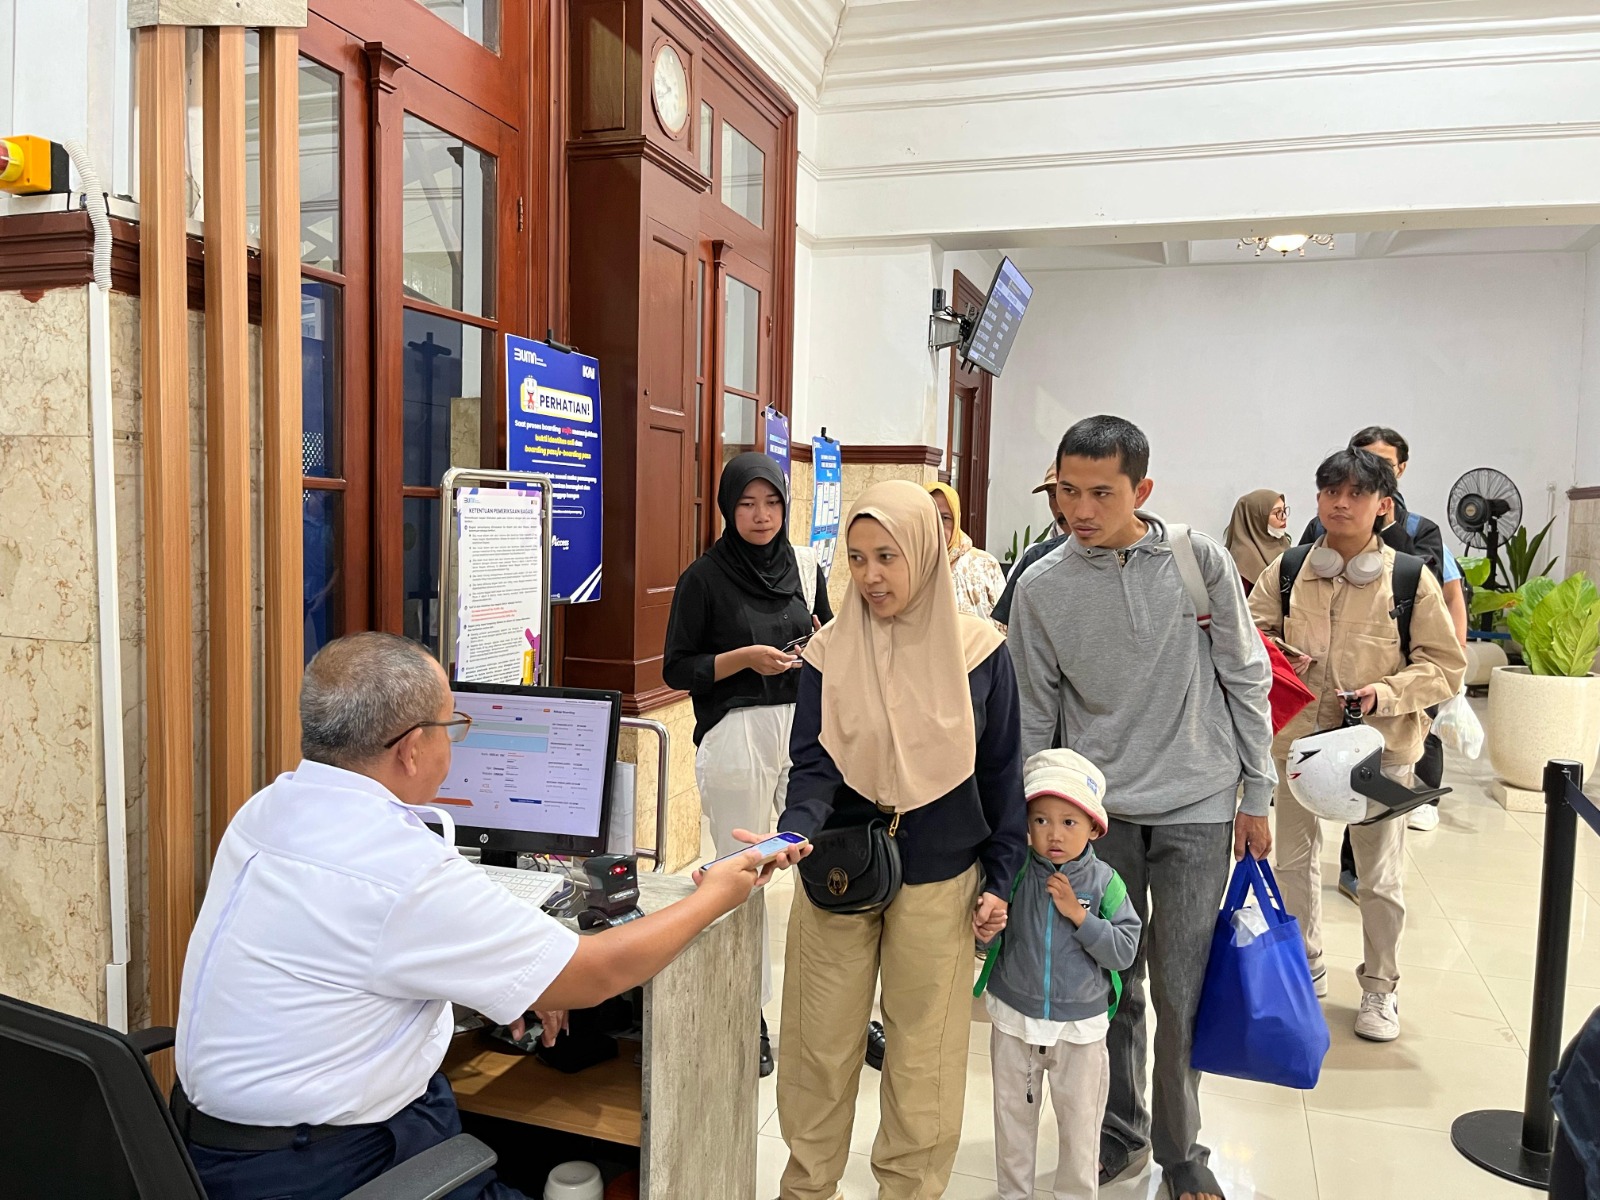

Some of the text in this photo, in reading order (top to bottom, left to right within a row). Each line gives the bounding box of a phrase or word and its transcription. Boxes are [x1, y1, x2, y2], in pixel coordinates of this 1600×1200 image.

[540, 394, 590, 416] PERHATIAN!
[515, 420, 526, 428] Saat
[542, 424, 561, 434] boarding
[525, 445, 546, 456] boarding
